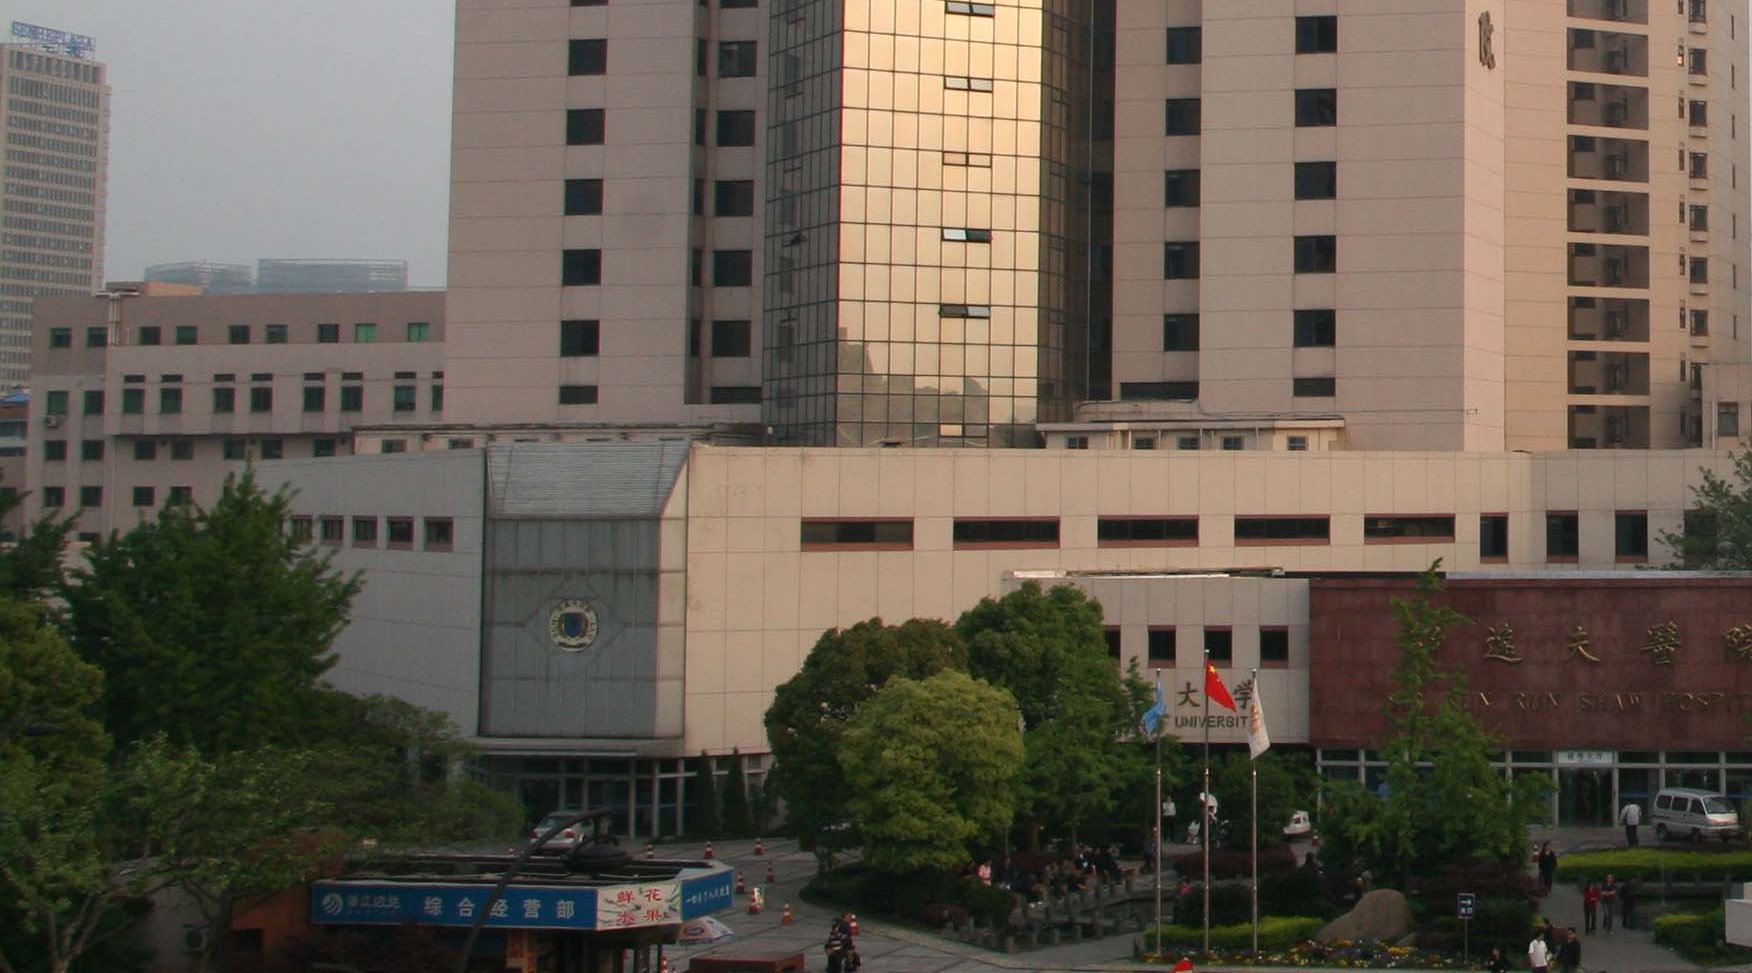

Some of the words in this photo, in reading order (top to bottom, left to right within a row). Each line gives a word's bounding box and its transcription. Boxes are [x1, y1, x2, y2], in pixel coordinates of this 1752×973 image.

[1177, 679, 1253, 710] 大学
[1174, 714, 1249, 729] UNIVERSIT
[616, 887, 664, 905] 鲜花
[423, 896, 577, 920] 综合经营部
